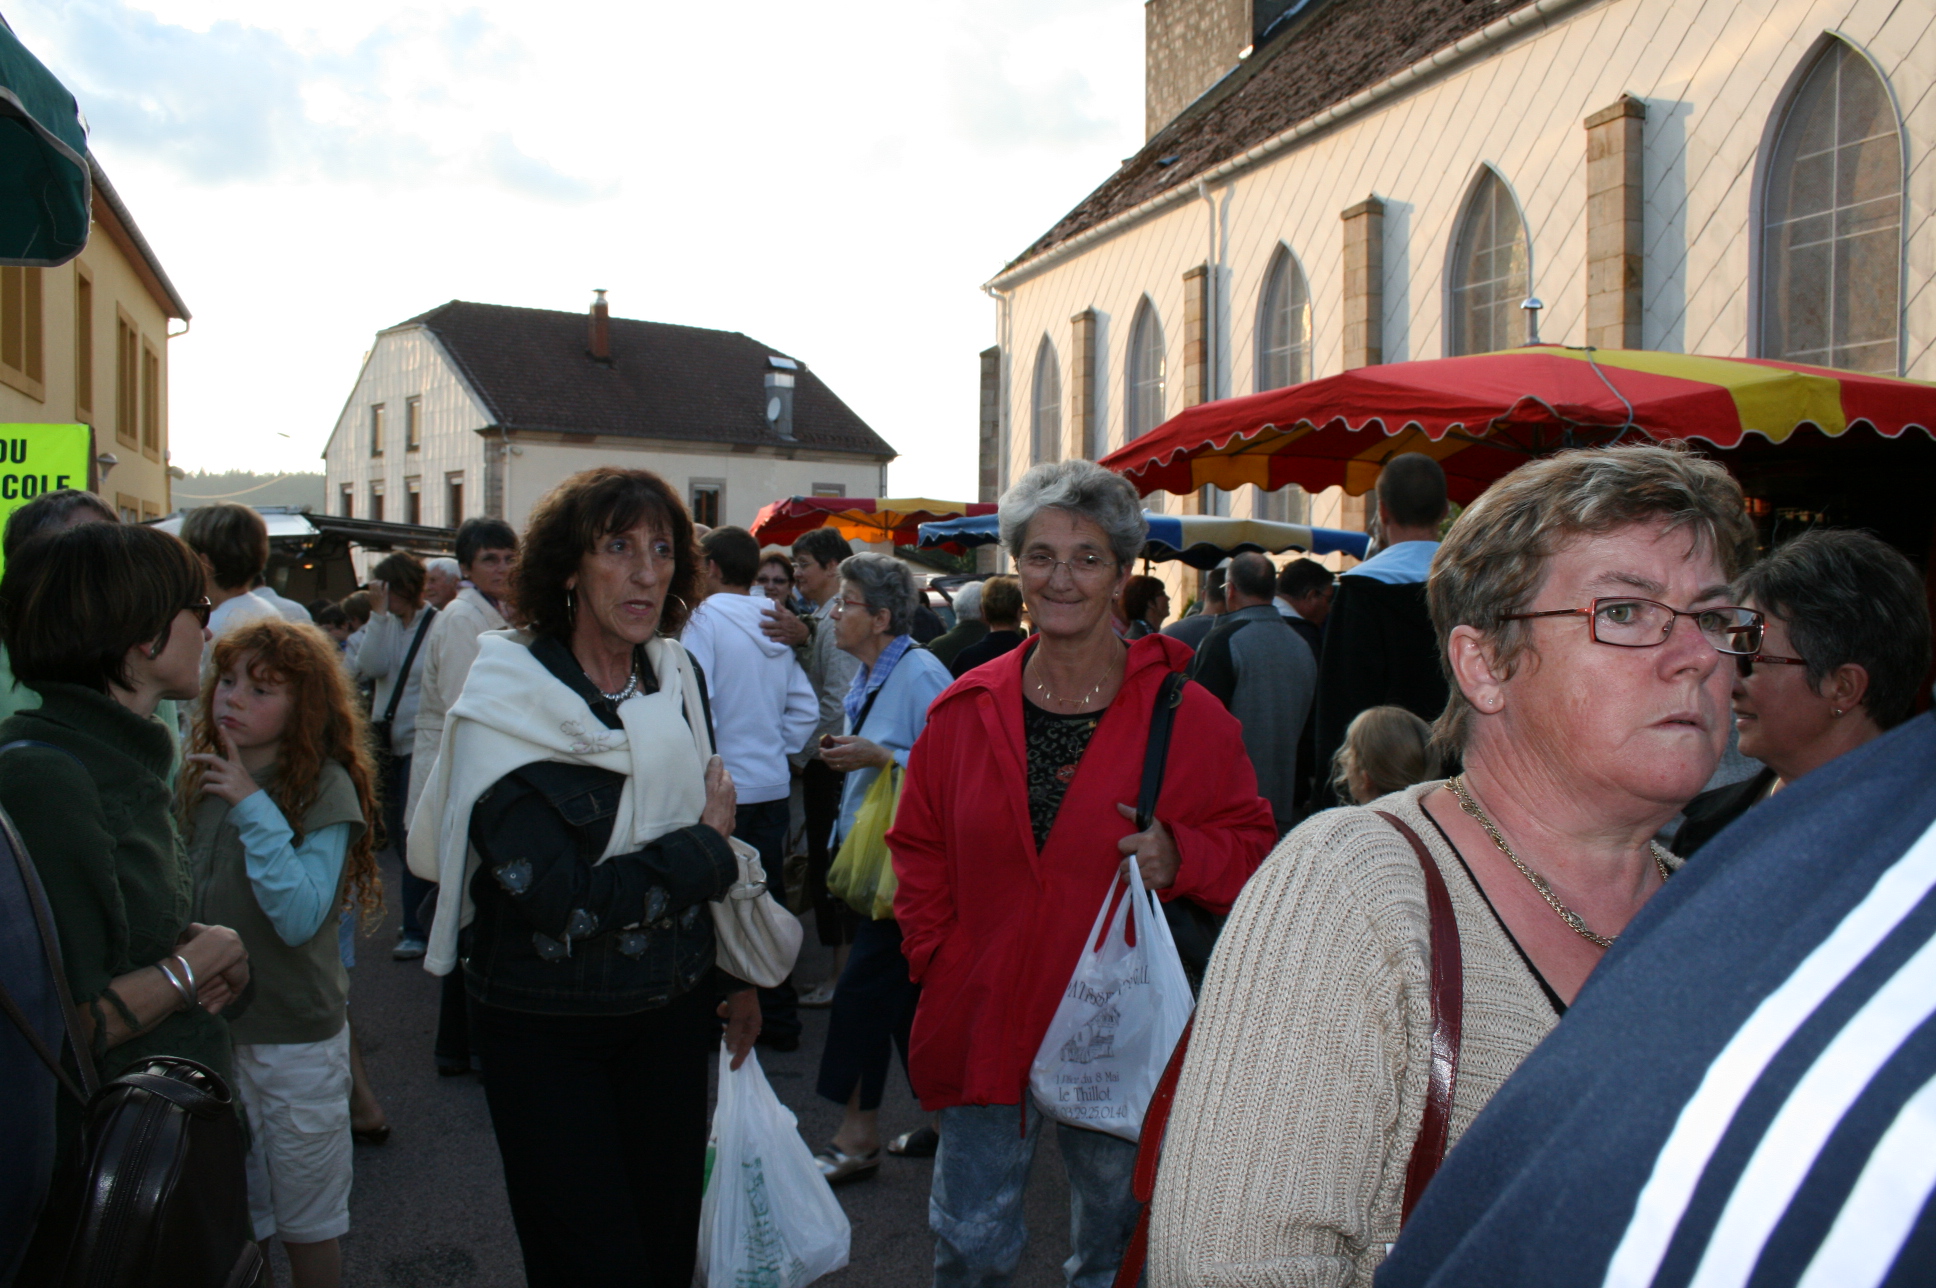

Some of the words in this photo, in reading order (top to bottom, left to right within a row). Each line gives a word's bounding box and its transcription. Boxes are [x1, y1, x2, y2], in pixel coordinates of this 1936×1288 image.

[1095, 1072, 1102, 1083] 8
[1104, 1071, 1120, 1083] Mai
[1073, 1085, 1112, 1102] Thillot
